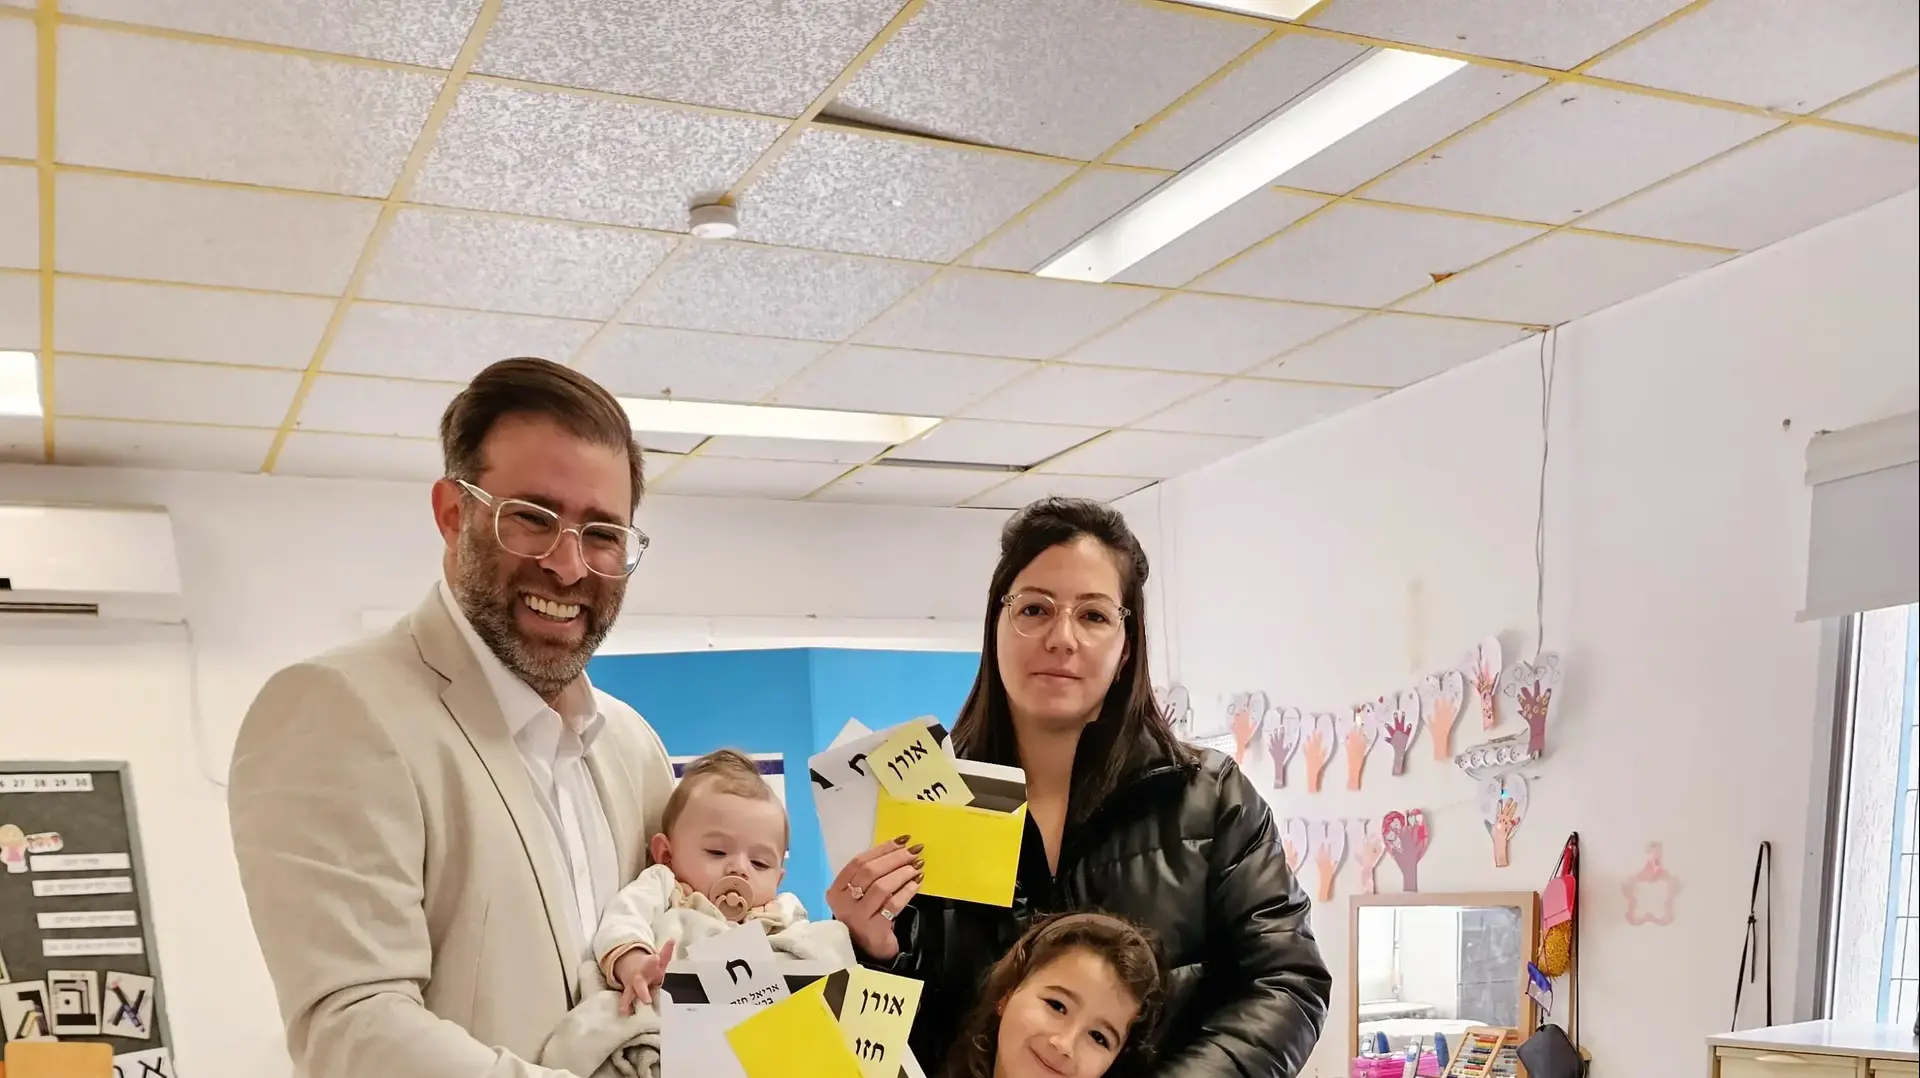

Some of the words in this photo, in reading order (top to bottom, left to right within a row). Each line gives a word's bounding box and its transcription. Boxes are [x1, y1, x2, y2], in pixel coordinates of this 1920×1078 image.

[887, 740, 928, 781] אורן
[725, 958, 752, 986] ח
[749, 983, 780, 1001] אריאל
[860, 987, 905, 1017] אורן
[855, 1037, 885, 1063] חזו
